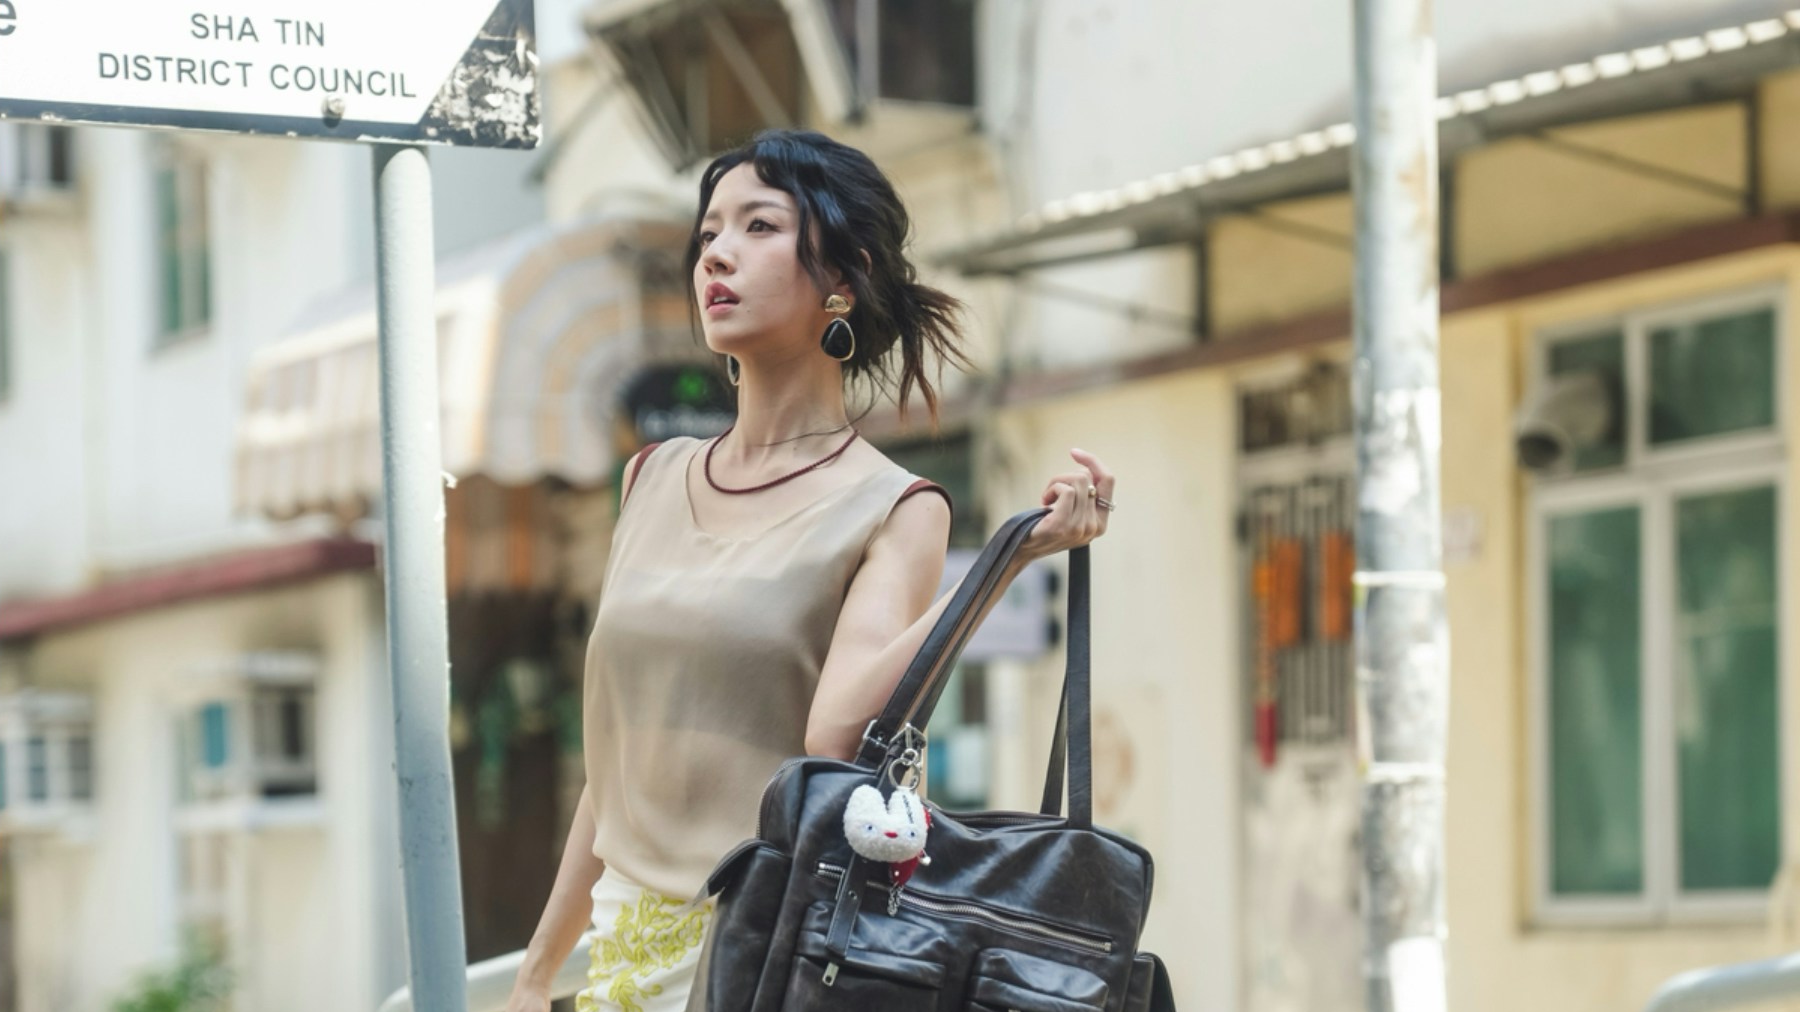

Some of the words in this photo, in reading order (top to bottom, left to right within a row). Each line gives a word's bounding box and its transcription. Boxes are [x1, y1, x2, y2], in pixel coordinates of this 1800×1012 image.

[191, 13, 259, 42] SHA
[274, 19, 325, 46] TIN
[98, 53, 253, 88] DISTRICT
[270, 64, 416, 98] COUNCIL
